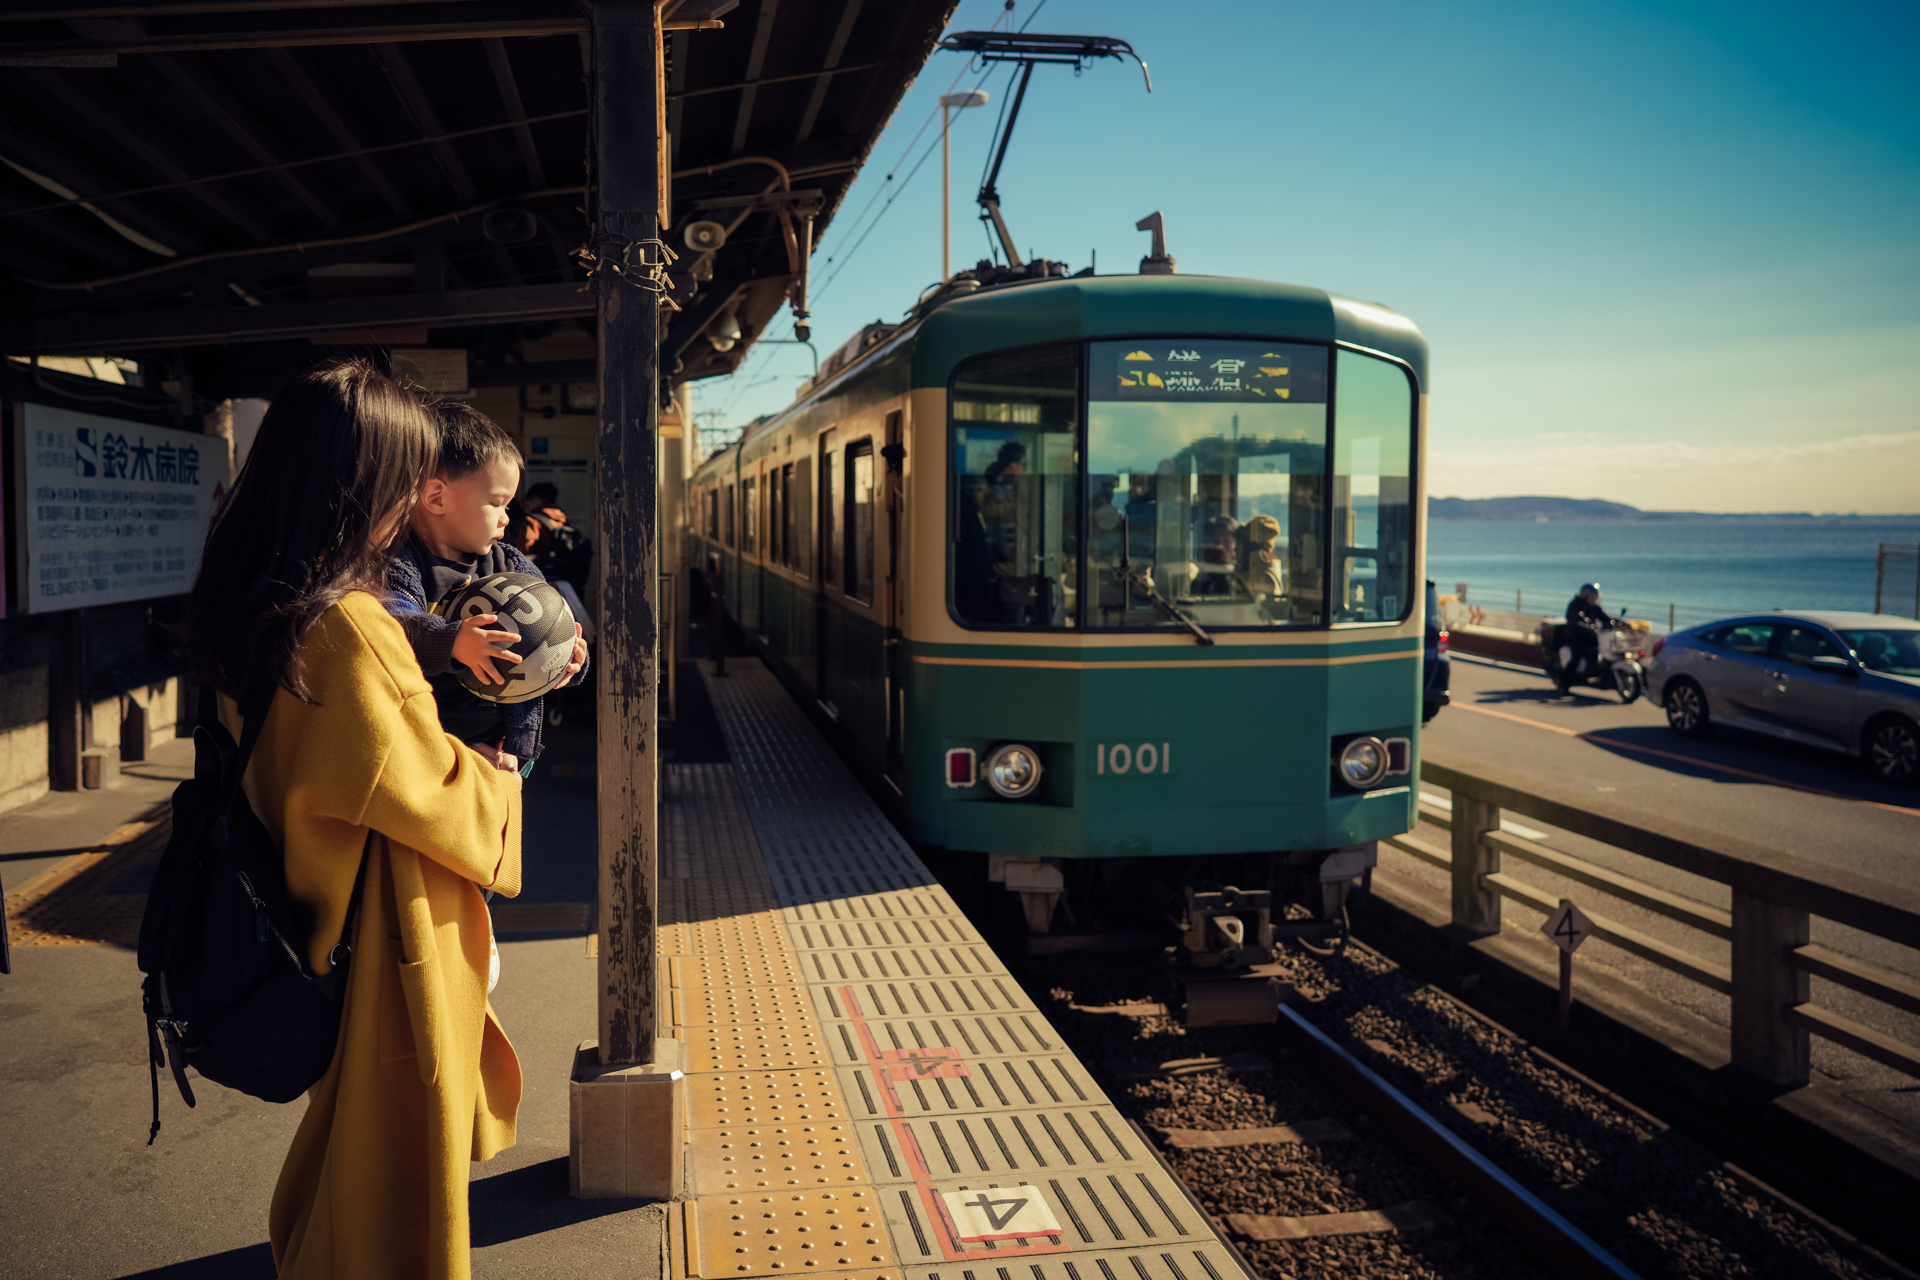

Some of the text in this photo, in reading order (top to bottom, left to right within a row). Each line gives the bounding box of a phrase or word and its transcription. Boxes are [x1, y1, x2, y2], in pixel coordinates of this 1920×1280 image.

[103, 431, 200, 486] 鈴木病院
[1097, 742, 1170, 775] 1001
[1554, 907, 1581, 943] 4
[898, 1053, 950, 1076] 4
[965, 1193, 1029, 1231] 4
